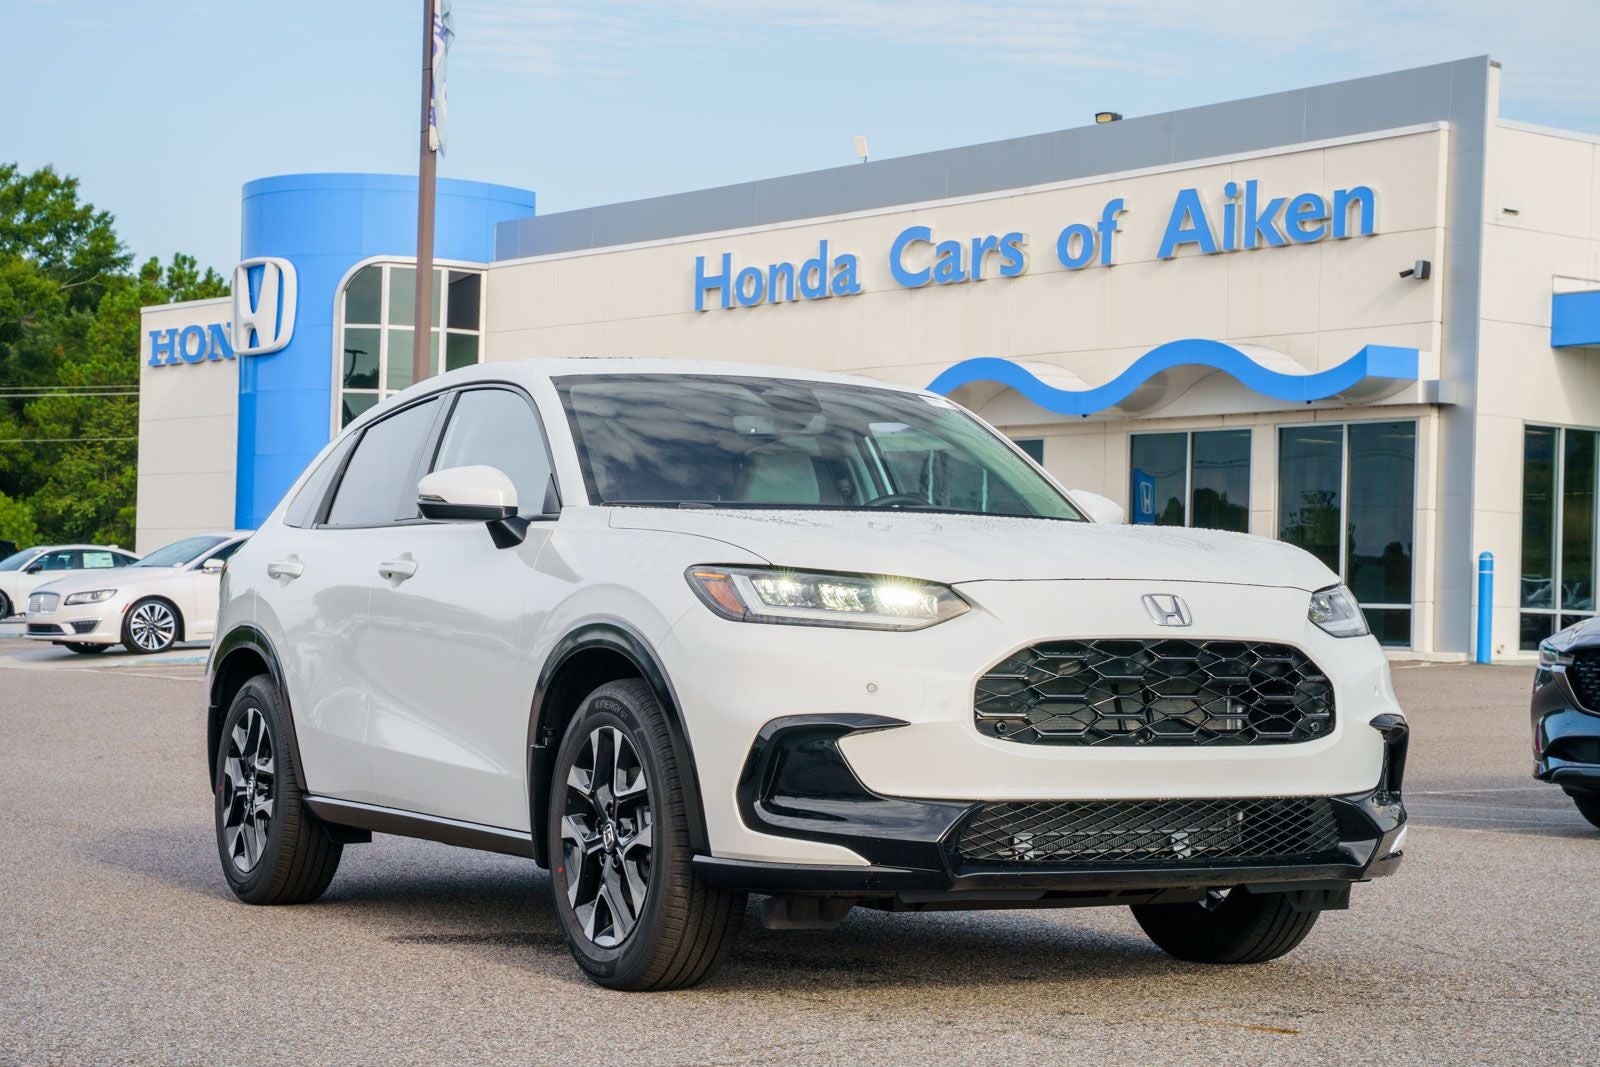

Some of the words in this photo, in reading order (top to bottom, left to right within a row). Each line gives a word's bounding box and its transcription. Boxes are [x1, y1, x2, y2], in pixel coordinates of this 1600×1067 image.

[695, 240, 863, 313] Honda
[890, 225, 1028, 290] Cars
[1057, 197, 1127, 271] of
[1157, 180, 1379, 260] Aiken
